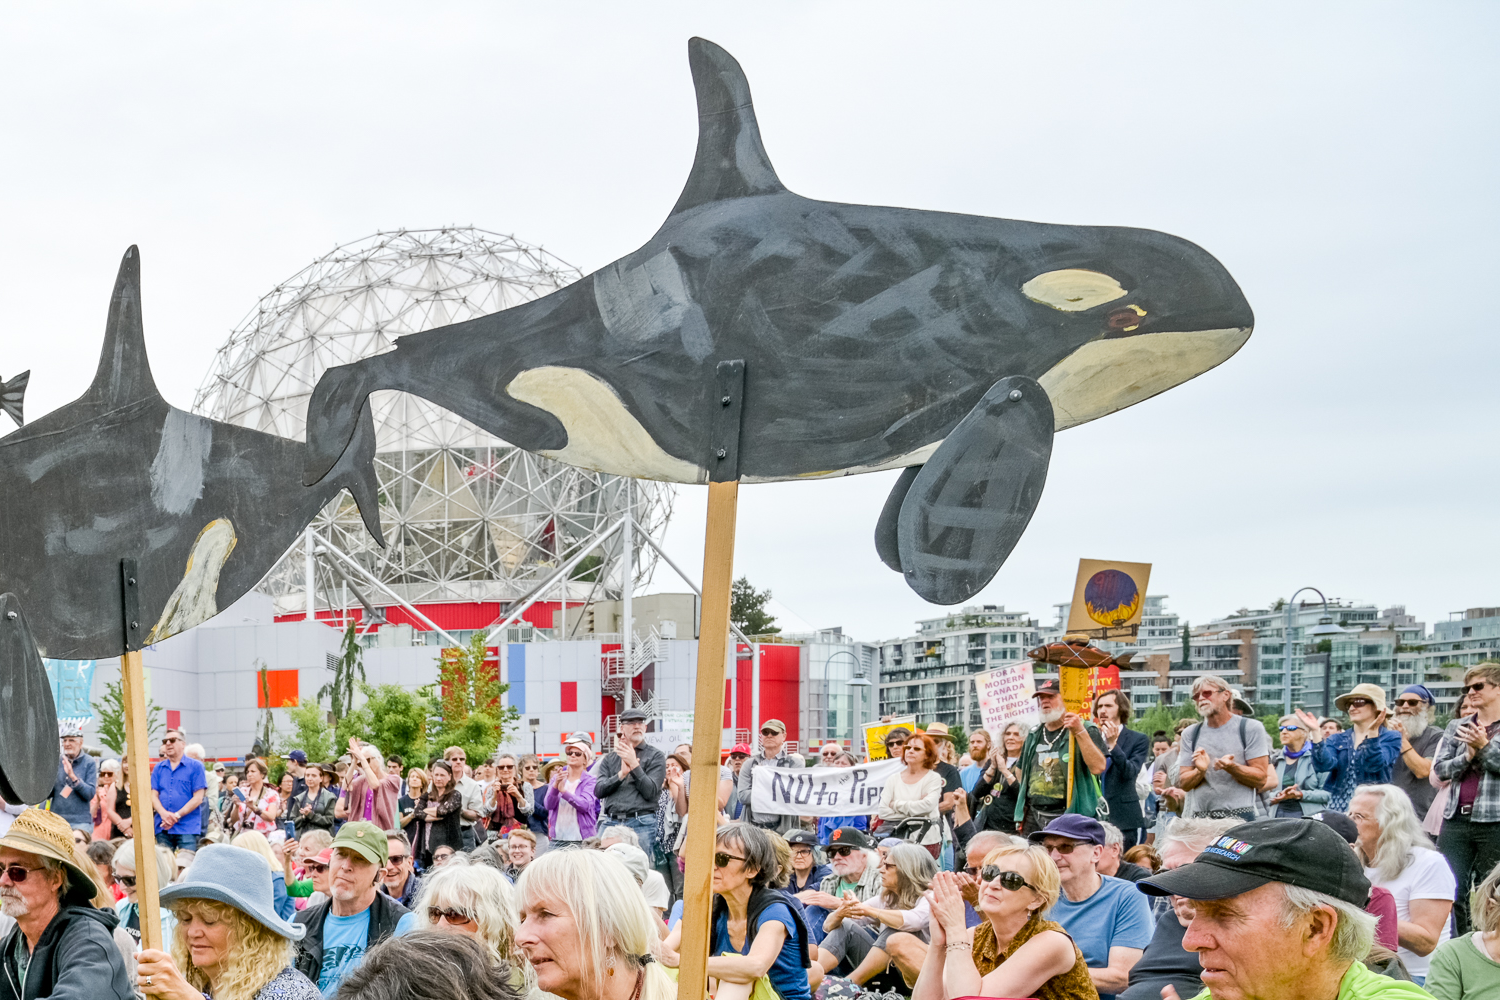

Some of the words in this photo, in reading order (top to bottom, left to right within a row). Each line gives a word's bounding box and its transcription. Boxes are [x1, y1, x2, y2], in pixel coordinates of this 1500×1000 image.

[990, 669, 1008, 679] FOR
[1010, 667, 1016, 675] A
[984, 674, 1025, 690] MODERN
[986, 682, 1026, 698] CANADA
[996, 692, 1019, 704] THAT
[985, 714, 1003, 724] THE
[1004, 705, 1036, 720] RIGHTS
[988, 698, 1030, 715] DEFENDS
[668, 734, 682, 743] OIL
[771, 771, 814, 805] NO
[813, 782, 839, 806] to
